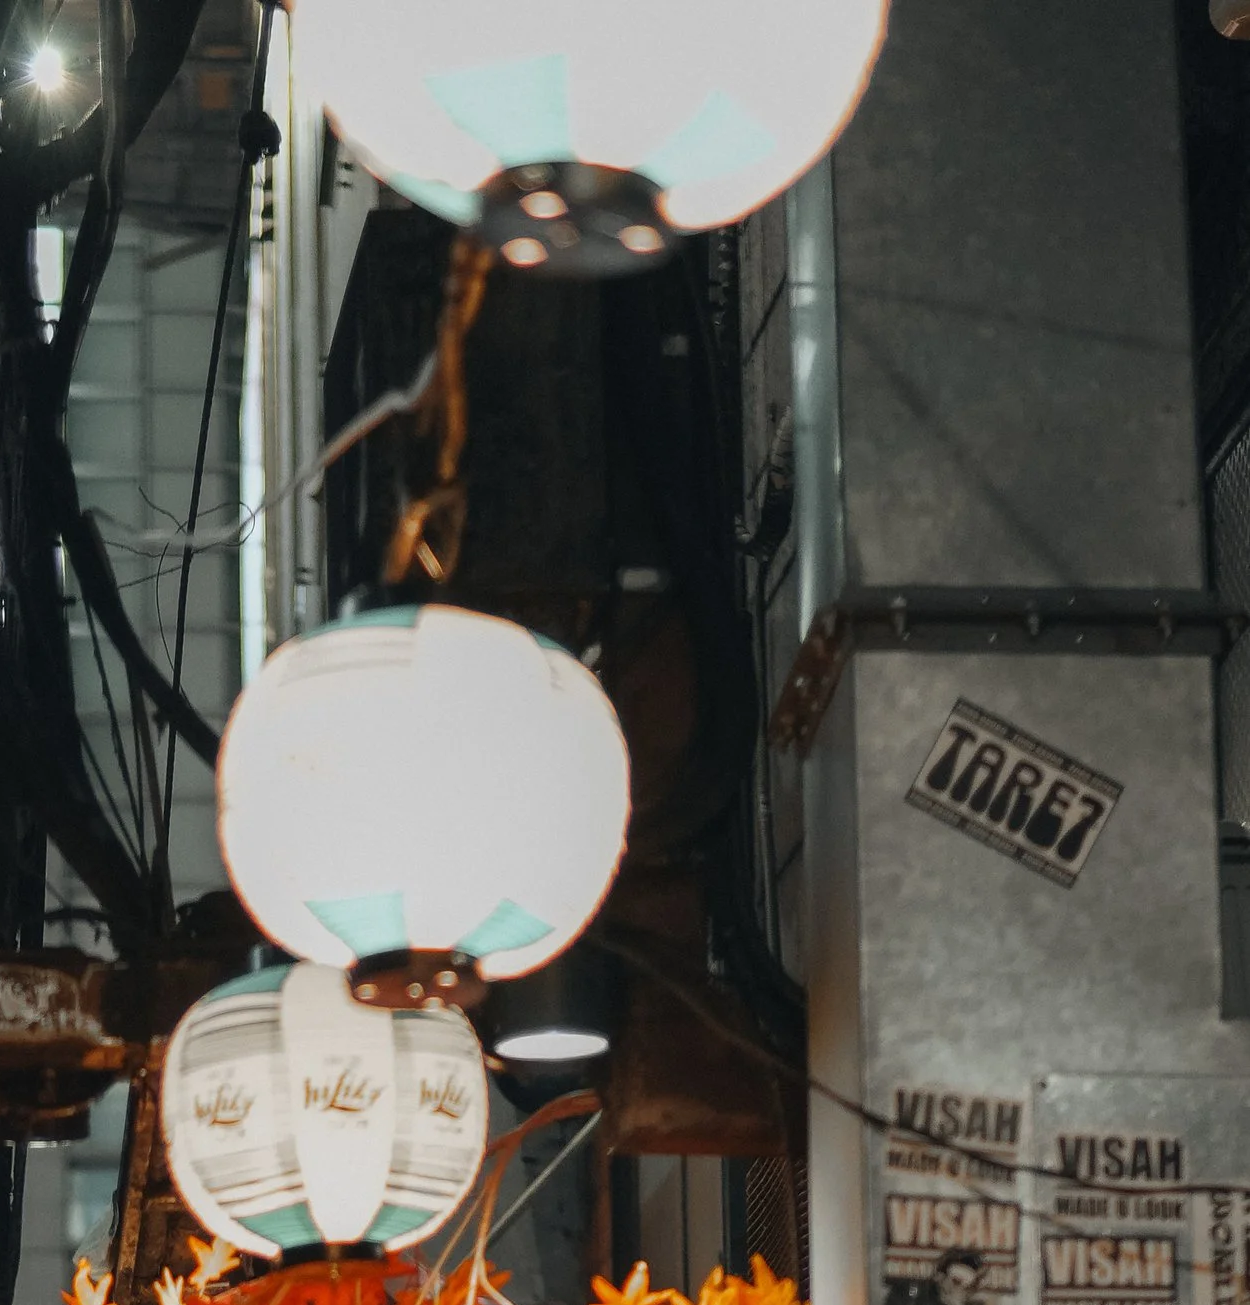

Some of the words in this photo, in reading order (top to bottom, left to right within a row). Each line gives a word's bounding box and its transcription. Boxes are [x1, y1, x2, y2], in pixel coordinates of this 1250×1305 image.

[897, 1089, 1023, 1144] VISAH
[1058, 1136, 1182, 1181] VISAH
[889, 1199, 1016, 1250] VISAH
[1046, 1239, 1172, 1286] VISAH
